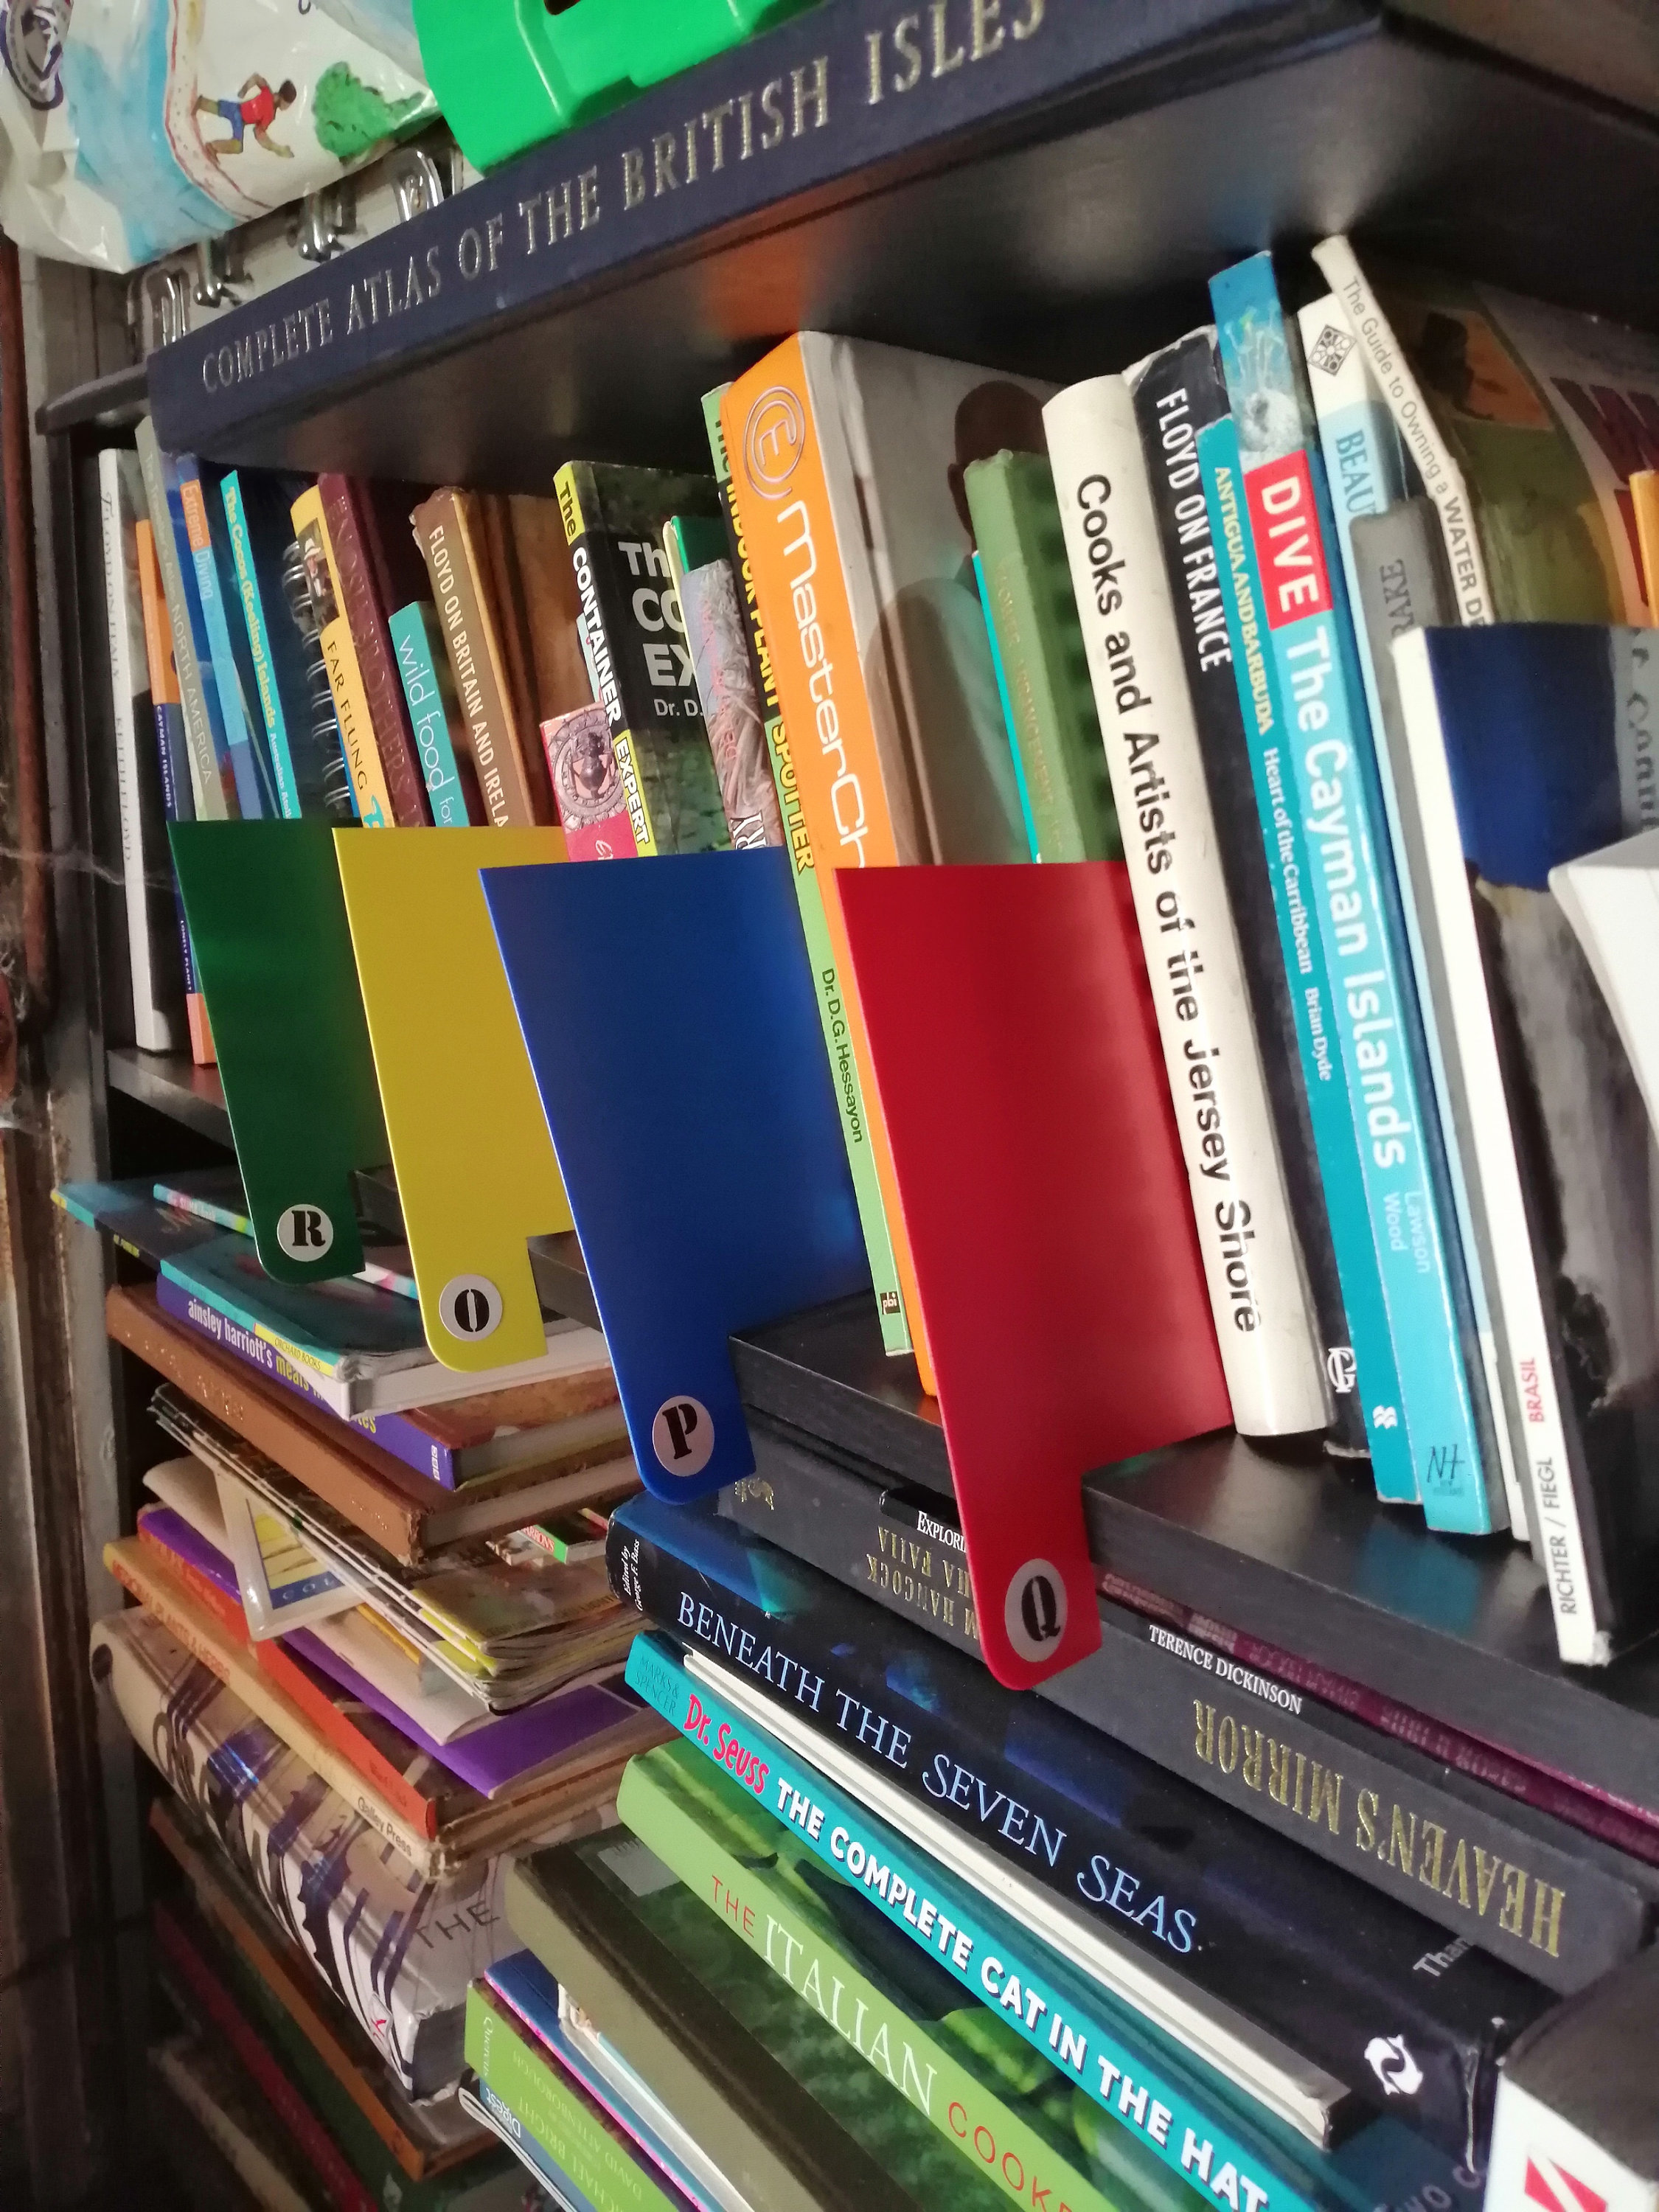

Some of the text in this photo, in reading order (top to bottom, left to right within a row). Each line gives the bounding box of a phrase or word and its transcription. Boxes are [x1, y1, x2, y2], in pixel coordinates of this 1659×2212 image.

[203, 297, 334, 393] COMPLETE
[347, 245, 442, 335] ATLAS
[458, 214, 504, 280] OF
[519, 164, 601, 255] THE
[622, 56, 830, 211] BRITISH
[1343, 276, 1366, 316] The
[1361, 318, 1393, 372] Guide
[1388, 376, 1405, 399] to
[1400, 401, 1443, 478] Owning
[1436, 481, 1448, 495] a
[1444, 495, 1479, 593] WATER
[181, 484, 205, 548] Extreme
[225, 485, 239, 524] The
[1157, 388, 1233, 672] FLOYD ON FRANCE
[1214, 465, 1246, 575] ANTIGUA
[231, 522, 247, 579] Cocos
[428, 524, 454, 595] FLOYD
[242, 576, 264, 663] (Keeling)
[443, 595, 464, 633] ON
[1231, 573, 1256, 630] AND
[172, 603, 194, 681] NORTH
[186, 686, 212, 785] AMERICA
[254, 661, 276, 729] Islands
[399, 633, 437, 707] wild
[452, 631, 484, 719] BRITAIN
[555, 480, 650, 845] The CONTAINER EXPERT
[1243, 627, 1275, 737] BARBUDA
[327, 641, 368, 790] FAR FLUNG
[653, 698, 681, 717] Dr.
[416, 710, 456, 792] food
[472, 720, 495, 768] AND
[1263, 747, 1284, 805] Heart
[161, 758, 173, 808] ISLANDS
[1261, 476, 1412, 1170] DIVE The Cayman Islands
[1273, 805, 1287, 832] of
[1278, 830, 1295, 863] the
[772, 723, 815, 875] SPOTTER
[821, 967, 836, 995] Dr.
[1077, 473, 1259, 1333] Cooks and Artists of the Jersey Shore
[1304, 987, 1324, 1037] Brian
[1312, 1035, 1332, 1082] Dyde
[291, 1209, 326, 1247] R
[1383, 1191, 1402, 1253] Wood
[1405, 1190, 1430, 1274] Lawson
[187, 1298, 223, 1340] ainsley
[224, 1318, 274, 1369] harriott's
[1519, 1357, 1545, 1424] BRASIL
[662, 1403, 698, 1460] P
[1535, 1457, 1561, 1512] FIEGL
[621, 1545, 632, 1596] Edited by
[631, 1539, 640, 1564] Bass
[1548, 1533, 1578, 1617] RICHTER
[631, 1579, 644, 1613] George
[866, 1553, 955, 1627] HANCOCK
[917, 1510, 967, 1554] EXPLORI
[1150, 1624, 1214, 1670] TERENCE
[1217, 1656, 1303, 1715] DICKINSON
[1020, 1574, 1061, 1643] Q
[635, 1671, 676, 1717] SPENCER
[639, 1656, 680, 1700] MARKS &
[678, 1591, 826, 1713] BENEATH
[835, 1688, 912, 1770] THE
[922, 1754, 1068, 1868] SEVEN
[1077, 1854, 1197, 1955] SEAS
[1192, 1699, 1343, 1837] MIRROR
[1356, 1787, 1567, 1959] HEAVEN'S
[415, 1899, 501, 1950] THE
[684, 1693, 1270, 2212] Dr. Seuss THE COMPLETE CAT IN THE HAT
[710, 1874, 756, 1938] THE
[762, 1914, 938, 2117] ITALIAN
[484, 2087, 521, 2139] Digest
[518, 2096, 566, 2160] BRIGHT
[605, 2152, 642, 2201] DAVID
